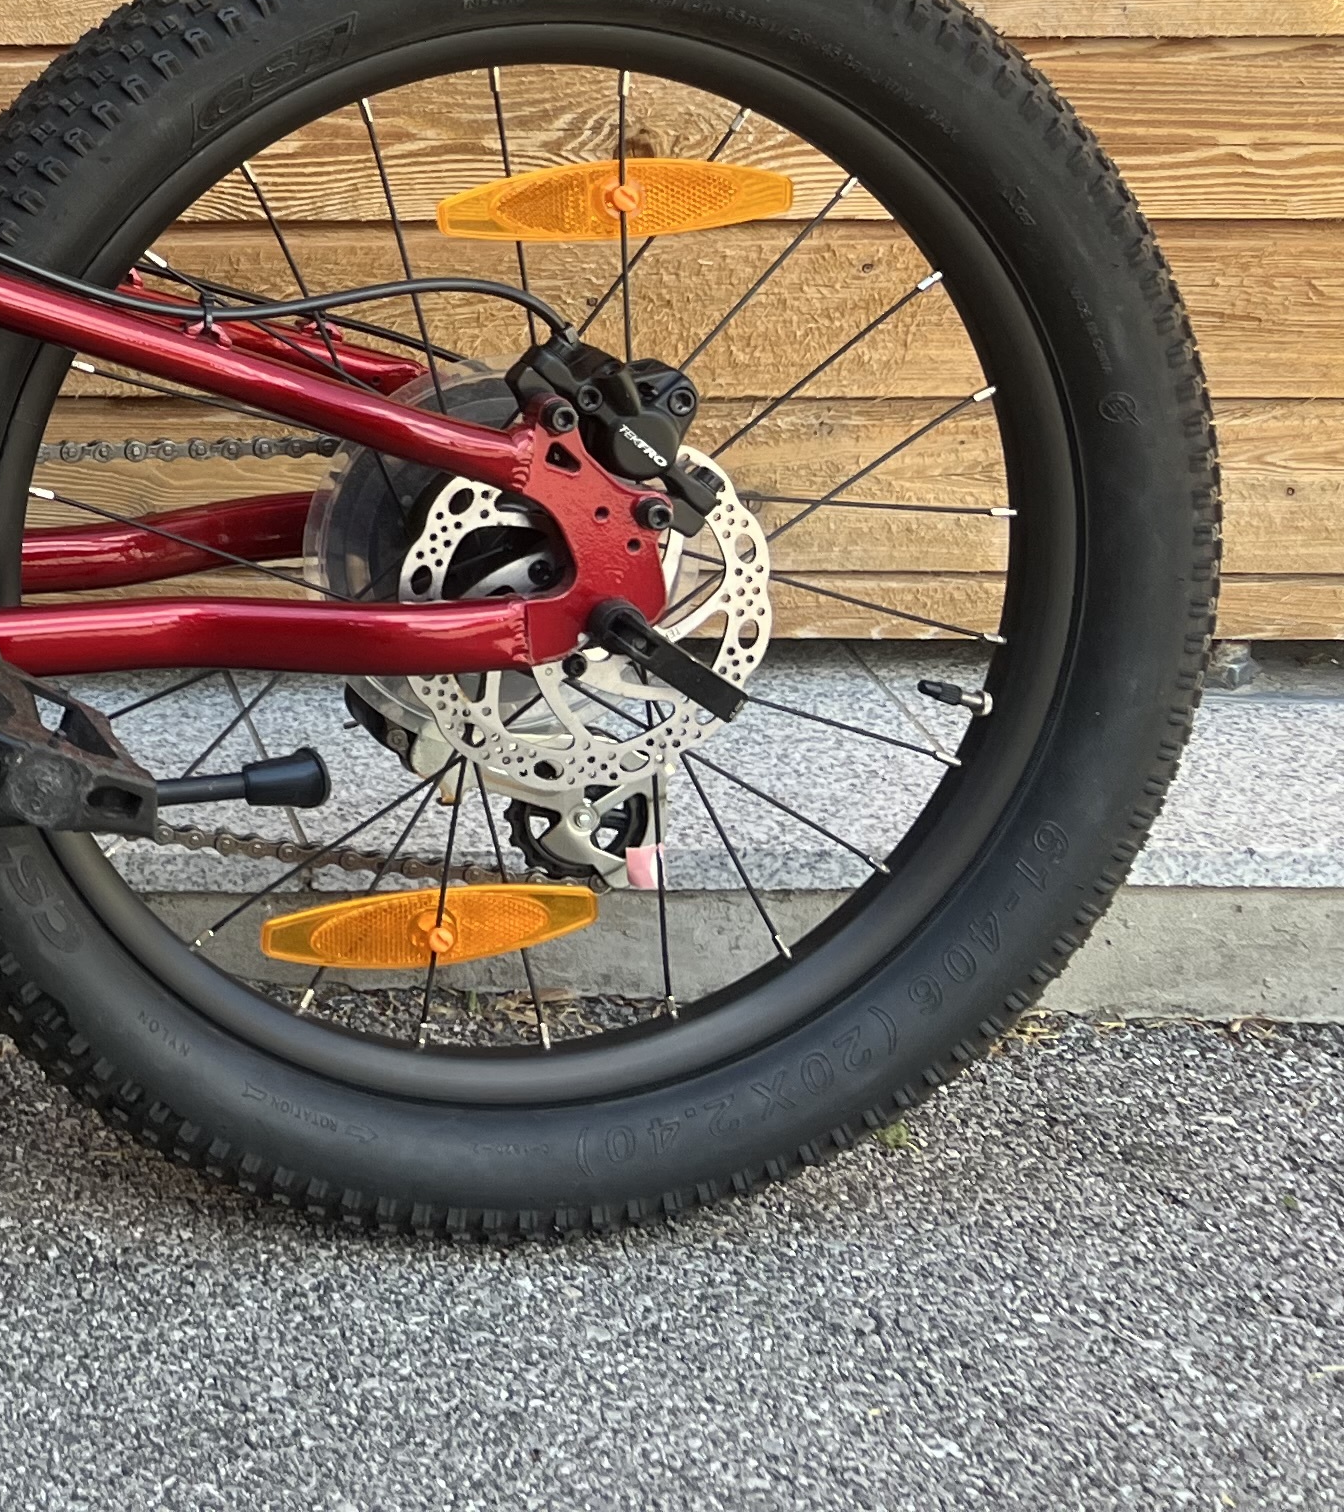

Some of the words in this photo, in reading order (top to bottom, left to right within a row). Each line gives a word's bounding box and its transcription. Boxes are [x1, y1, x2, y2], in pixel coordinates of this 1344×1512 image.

[198, 23, 349, 131] CST
[618, 423, 668, 467] TEKTRO
[133, 1008, 192, 1057] NYLON
[268, 1093, 340, 1132] ROTATION
